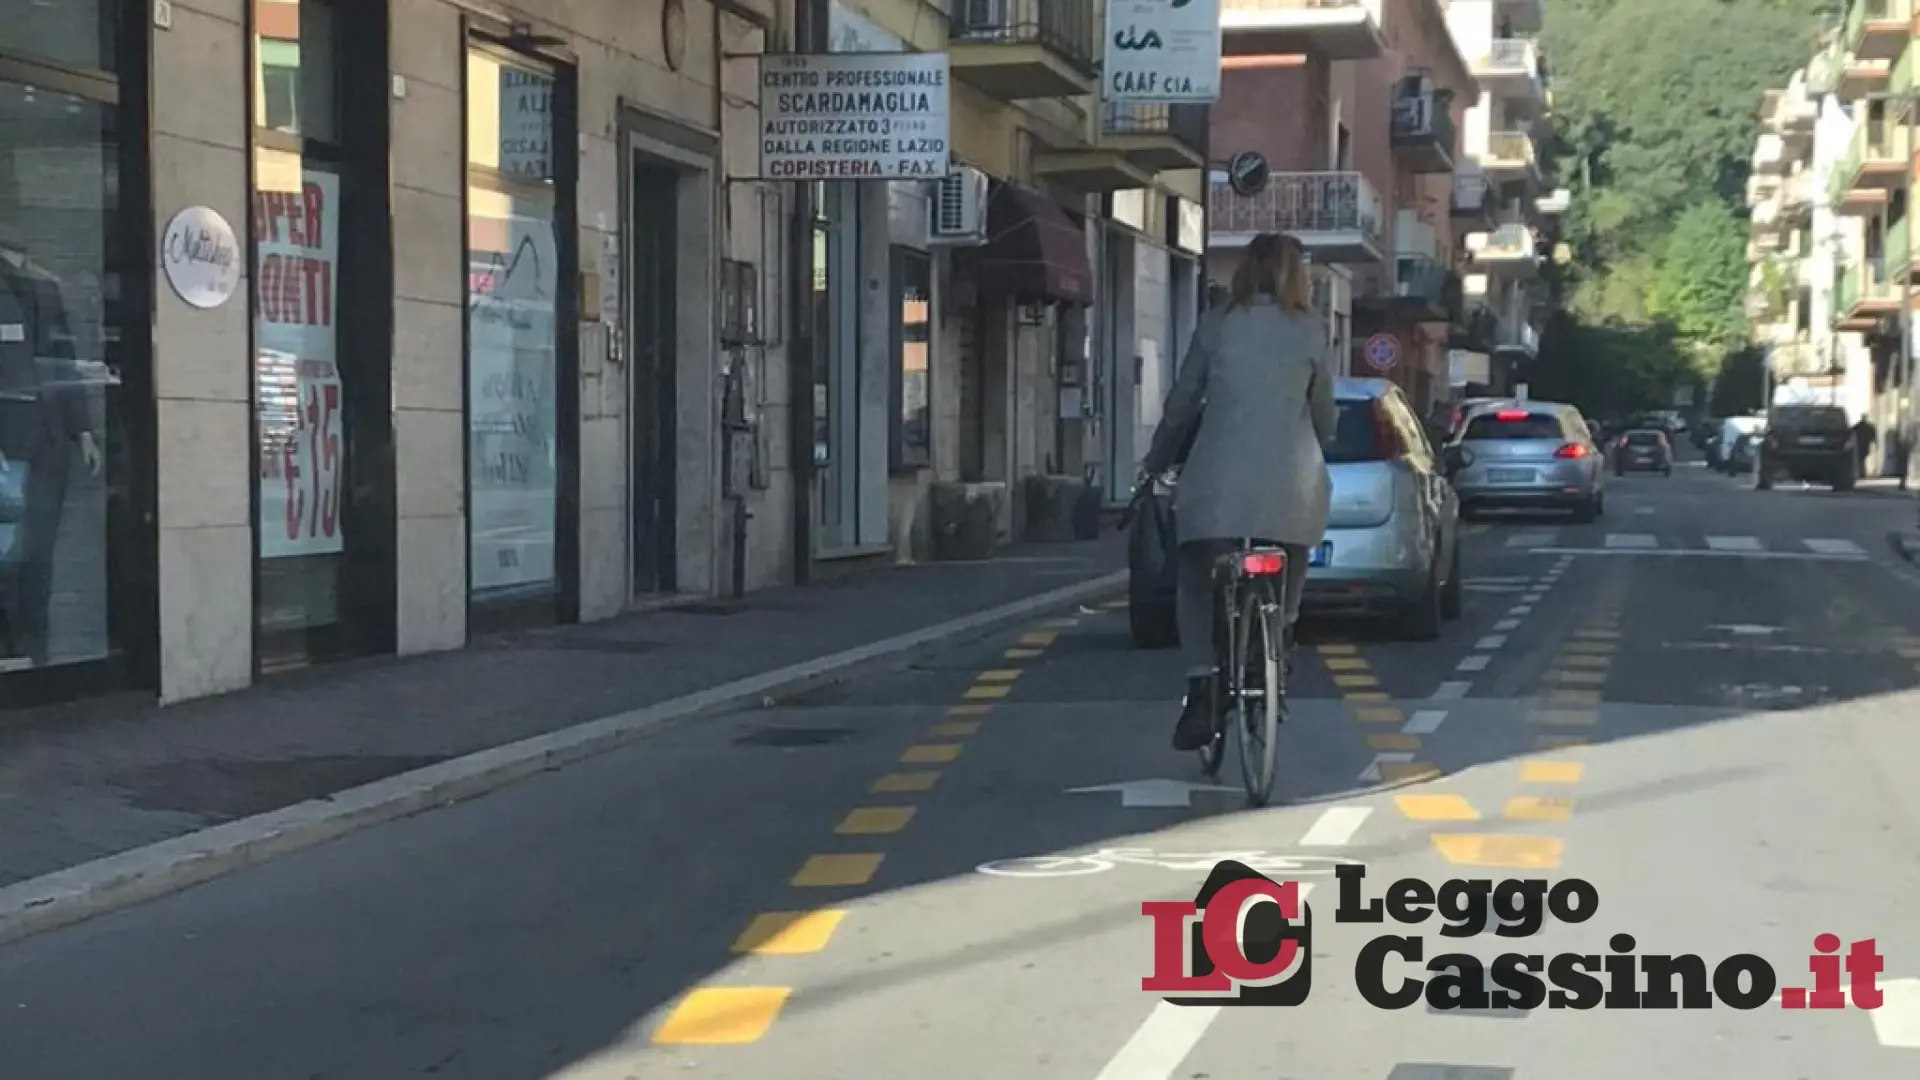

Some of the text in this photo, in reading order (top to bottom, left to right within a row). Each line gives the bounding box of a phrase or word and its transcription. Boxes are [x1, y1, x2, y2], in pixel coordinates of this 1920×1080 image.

[764, 69, 944, 87] CENTRO PROFESSIONALE
[1113, 71, 1158, 93] CAAF
[1163, 76, 1193, 94] CIA
[779, 91, 930, 113] SCARDAMAGLIA
[765, 119, 878, 135] AUTORIZZATO
[764, 138, 945, 154] DALLA REGIONE LAZIO
[770, 160, 882, 176] COPISTERIA
